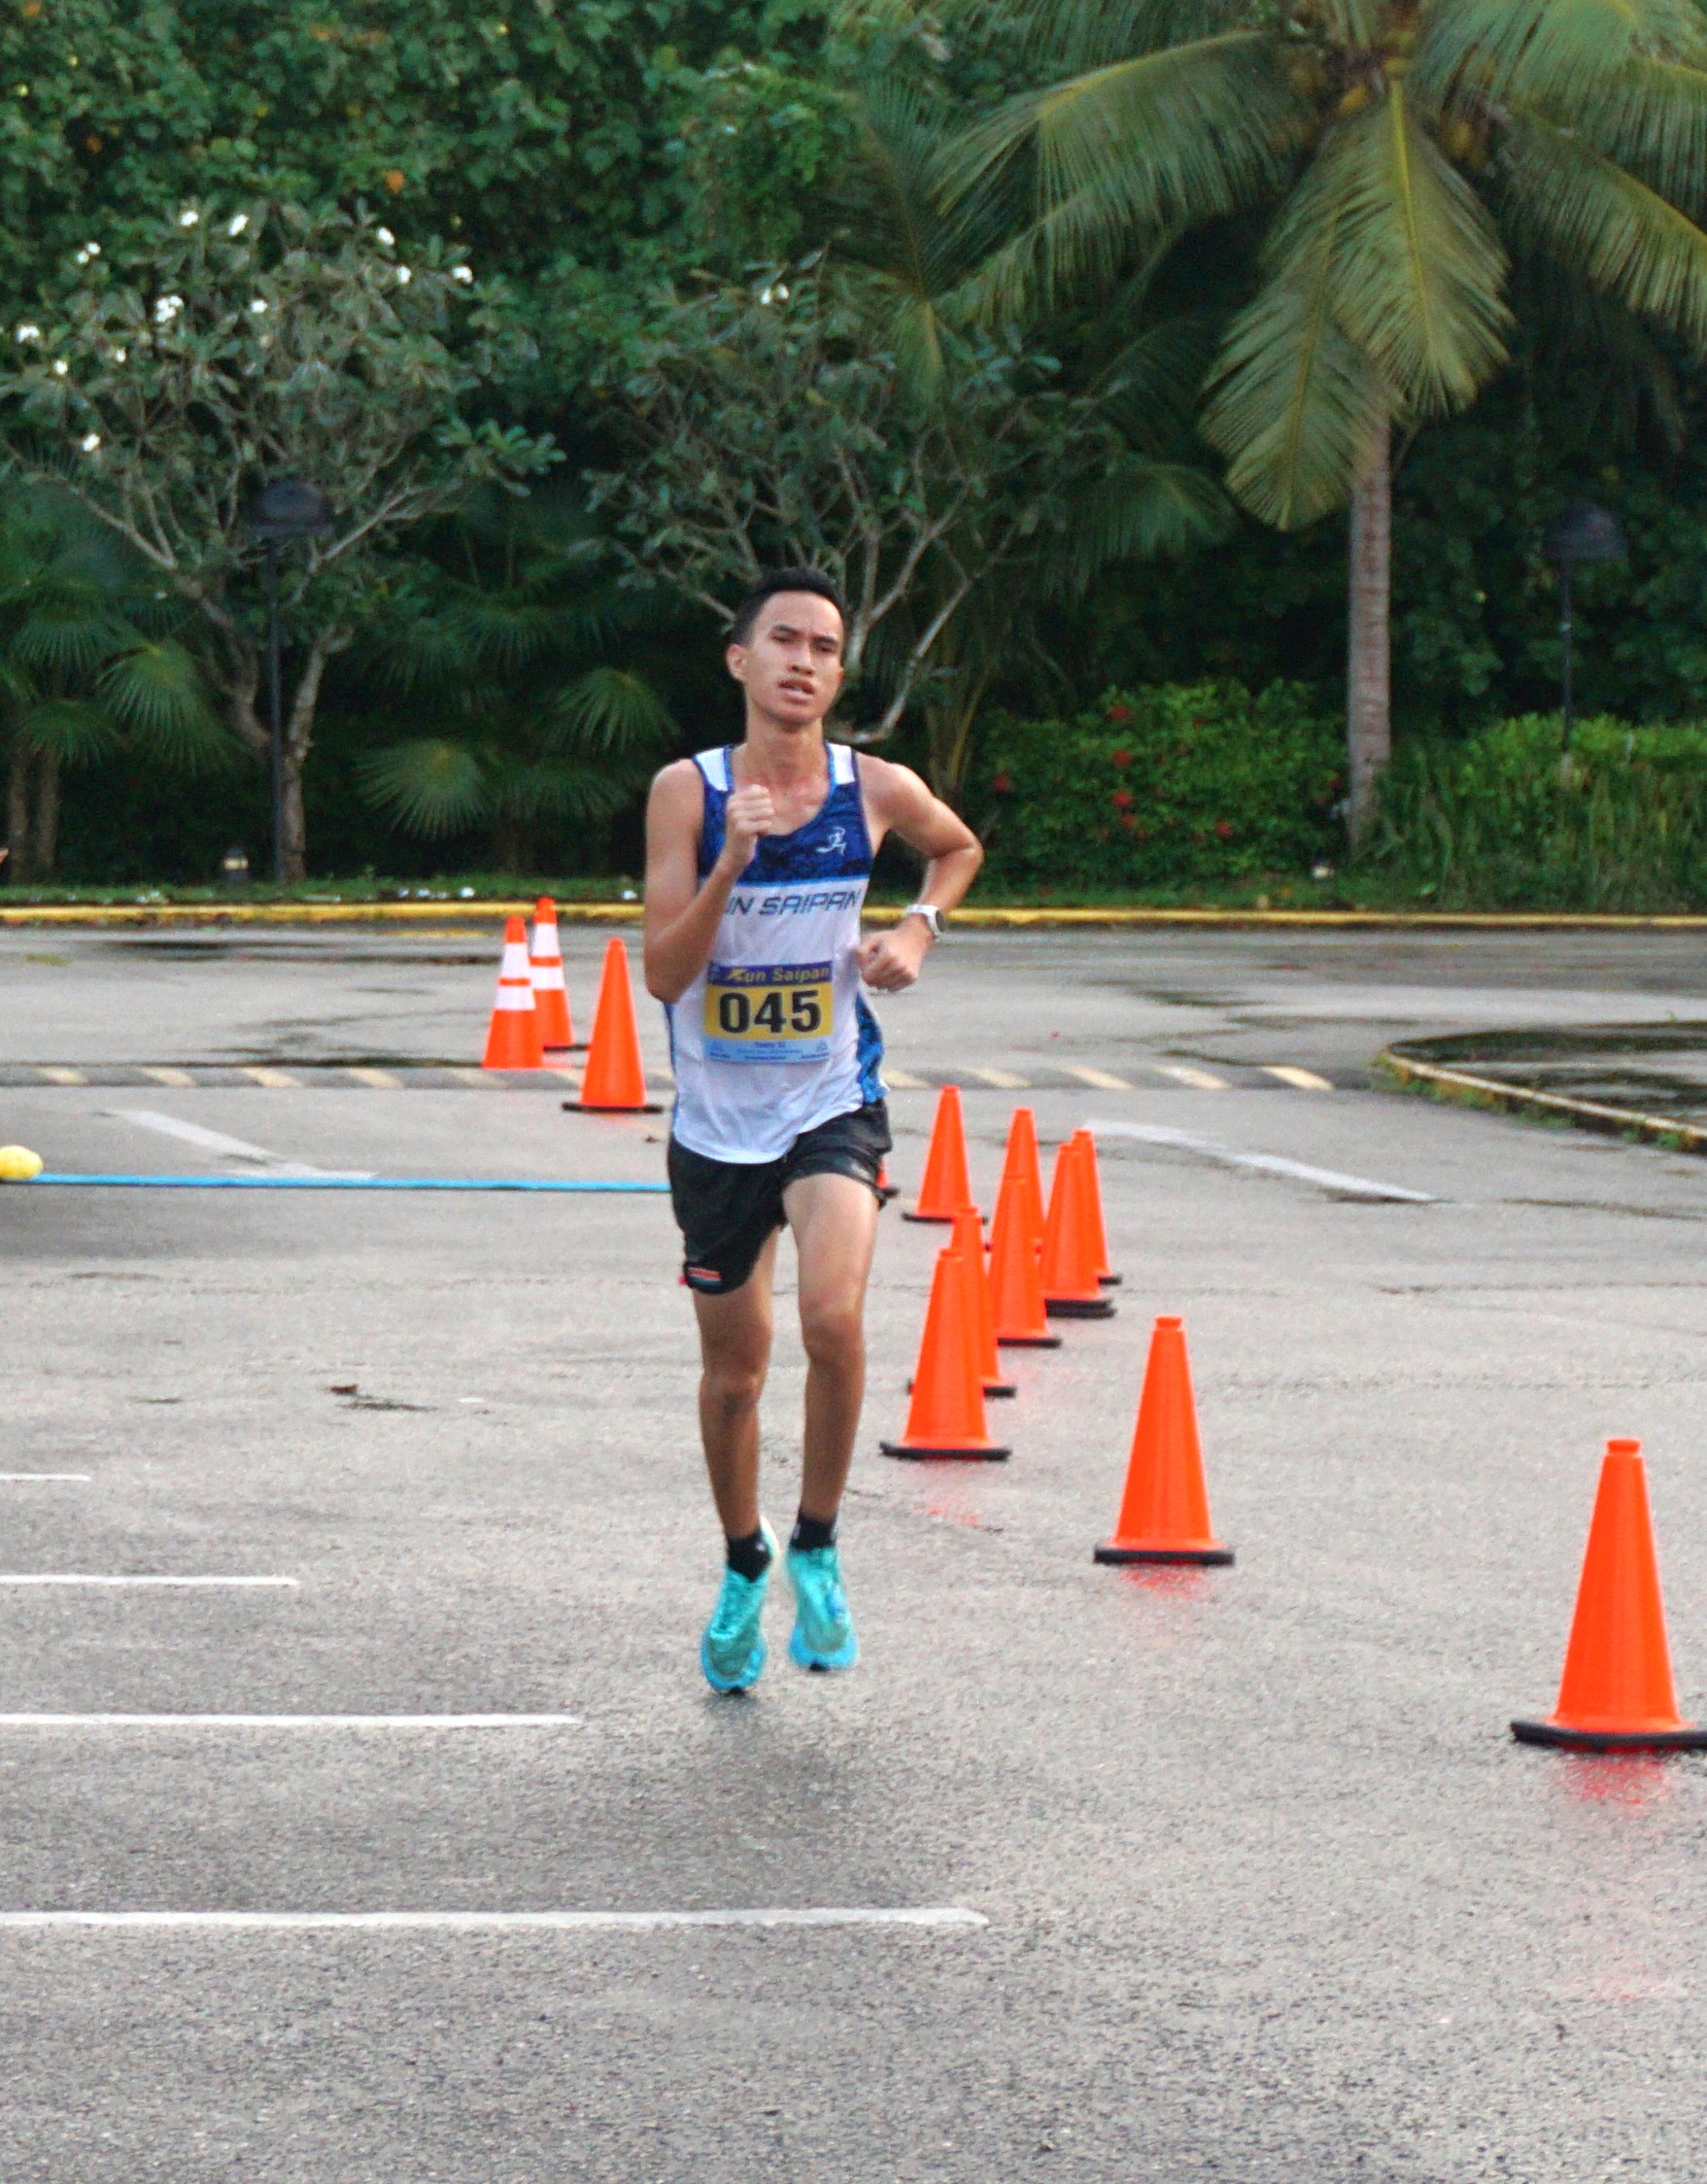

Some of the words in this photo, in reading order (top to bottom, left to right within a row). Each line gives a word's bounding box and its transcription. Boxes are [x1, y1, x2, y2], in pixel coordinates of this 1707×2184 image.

[759, 891, 860, 915] SAIPAN
[772, 967, 830, 983] Saipan
[719, 990, 821, 1035] 045
